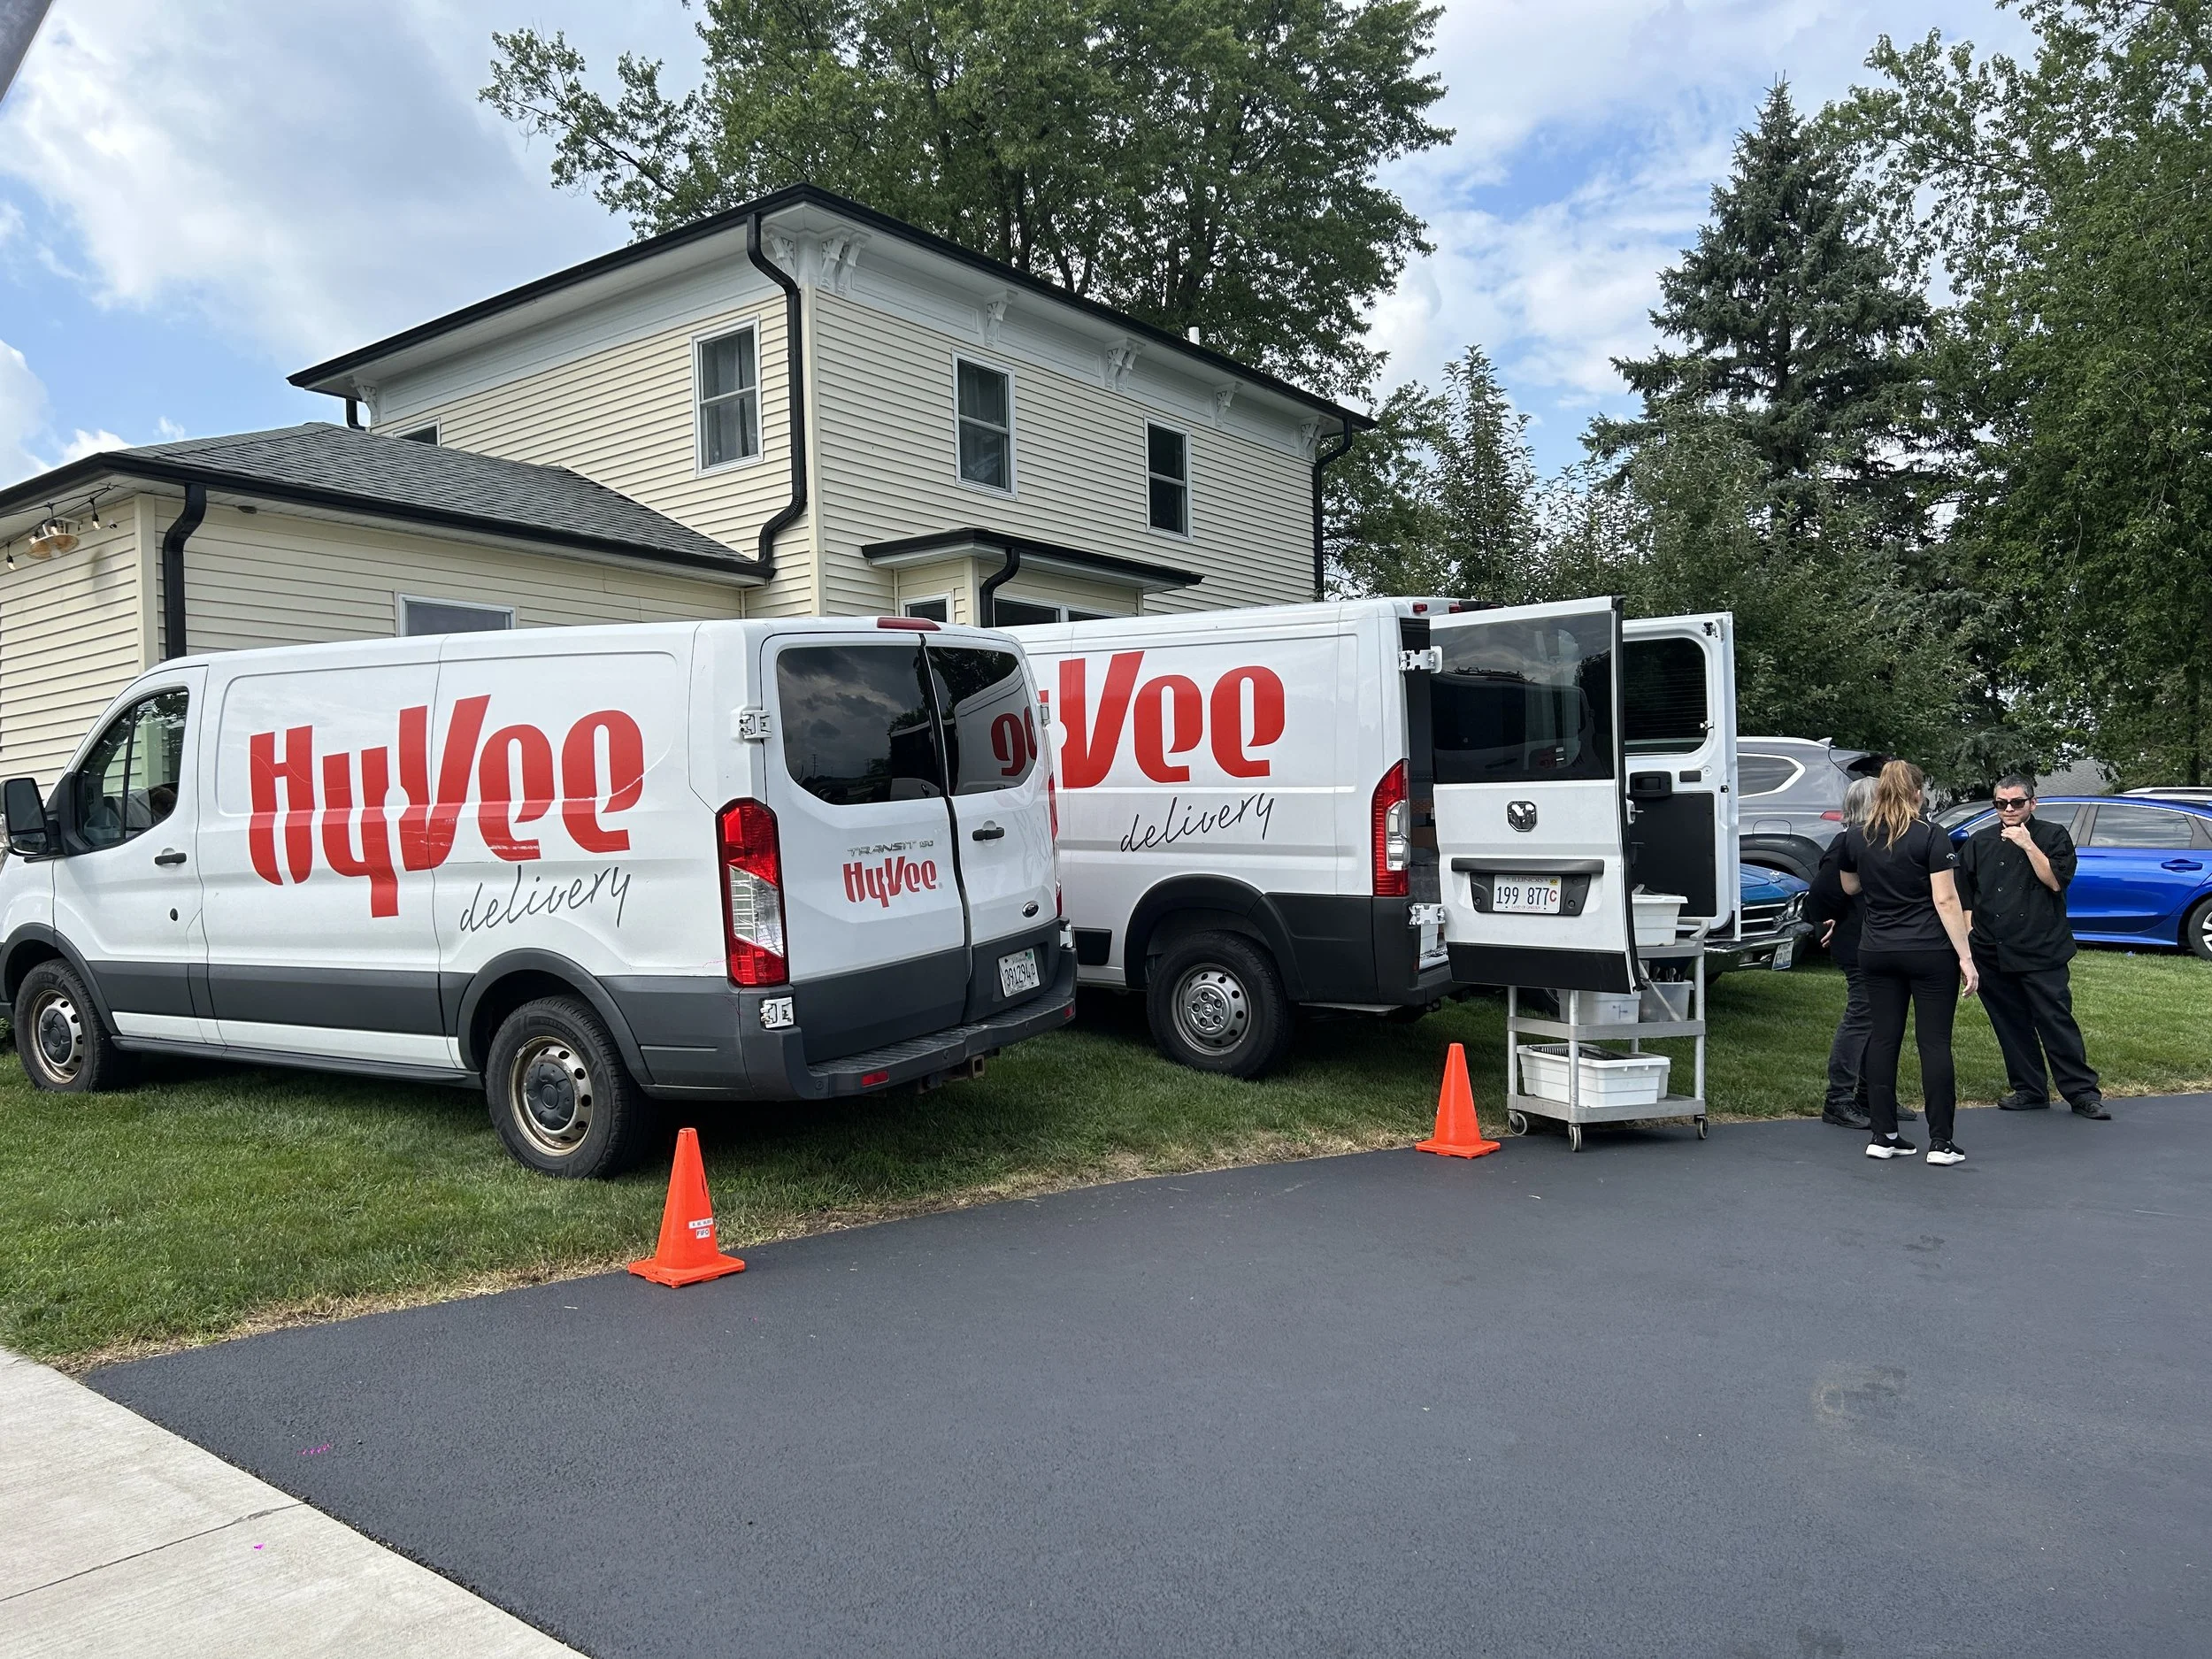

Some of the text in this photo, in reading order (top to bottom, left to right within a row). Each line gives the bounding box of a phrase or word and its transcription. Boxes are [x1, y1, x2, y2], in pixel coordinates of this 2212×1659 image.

[1038, 650, 1286, 789] Vee
[250, 695, 644, 918] HyVee
[1120, 793, 1275, 852] delivery
[847, 841, 917, 856] TRANSIT
[459, 864, 631, 933] delivery
[843, 856, 937, 908] HyVee
[1496, 886, 1519, 904] 199
